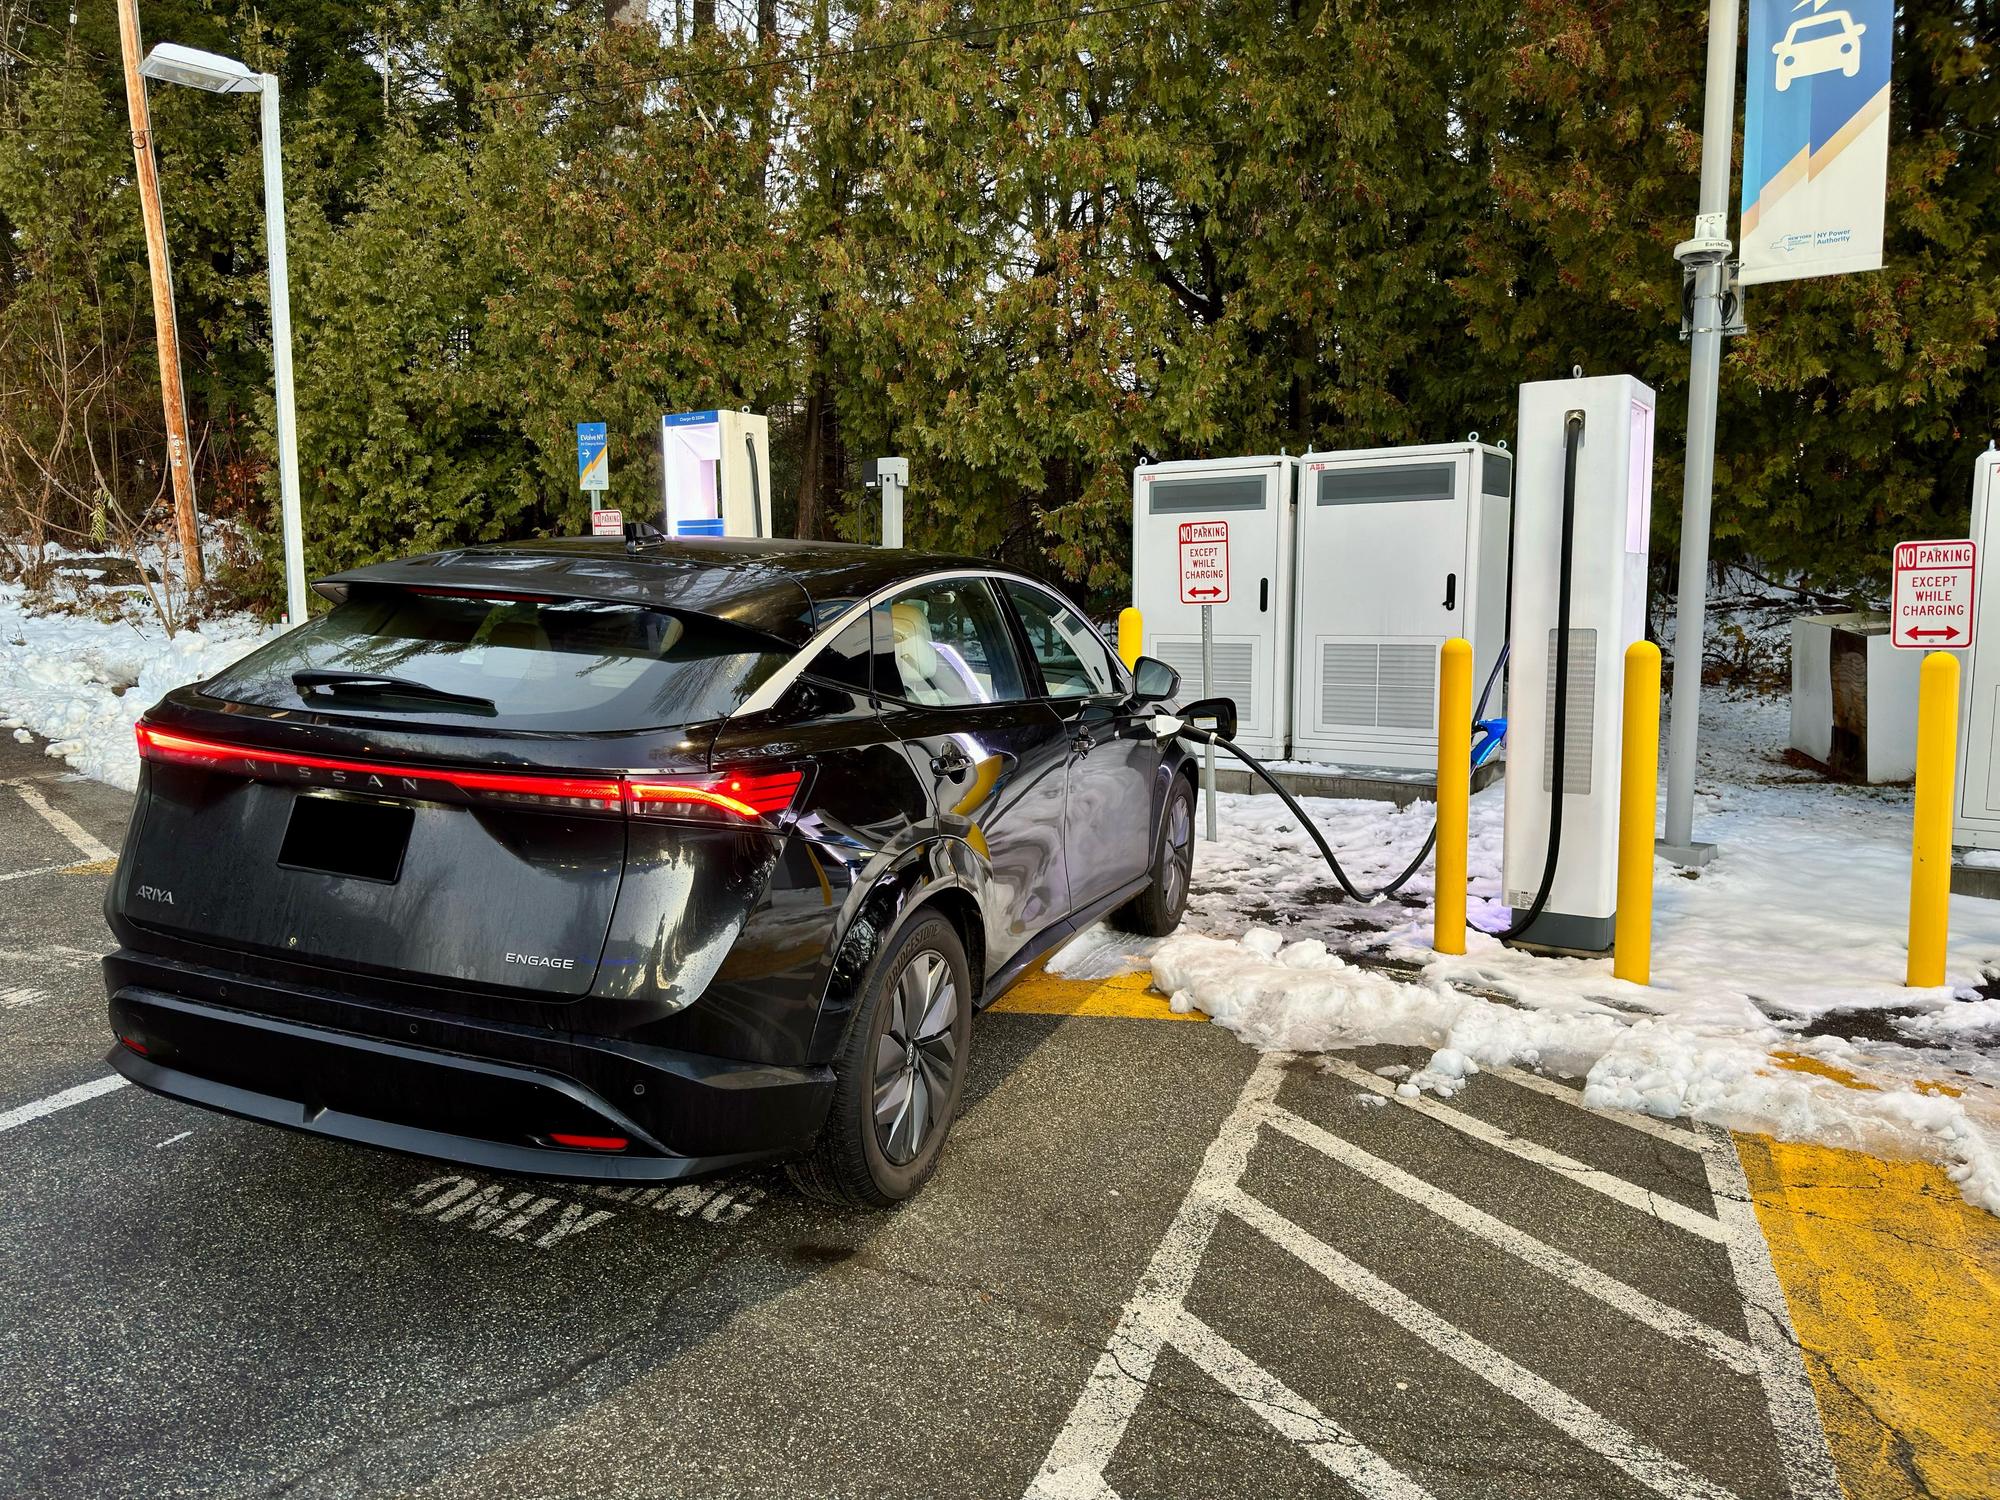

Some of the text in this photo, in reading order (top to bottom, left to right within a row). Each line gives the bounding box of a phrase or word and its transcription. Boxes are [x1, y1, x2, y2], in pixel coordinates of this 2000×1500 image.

[1829, 229, 1851, 237] Power
[1817, 235, 1850, 245] Authority
[1180, 525, 1225, 542] NO PARKING
[1189, 547, 1218, 557] EXCEPT
[1898, 547, 1971, 568] NO PARKING
[1192, 558, 1216, 568] WHILE
[1185, 569, 1224, 579] CHARGING
[1912, 576, 1957, 588] EXCEPT
[1915, 590, 1952, 602] WHILE
[1902, 605, 1964, 616] CHARGING
[243, 758, 418, 792] NISSAN
[135, 885, 175, 905] ARIYA
[505, 952, 575, 970] ENGAGE
